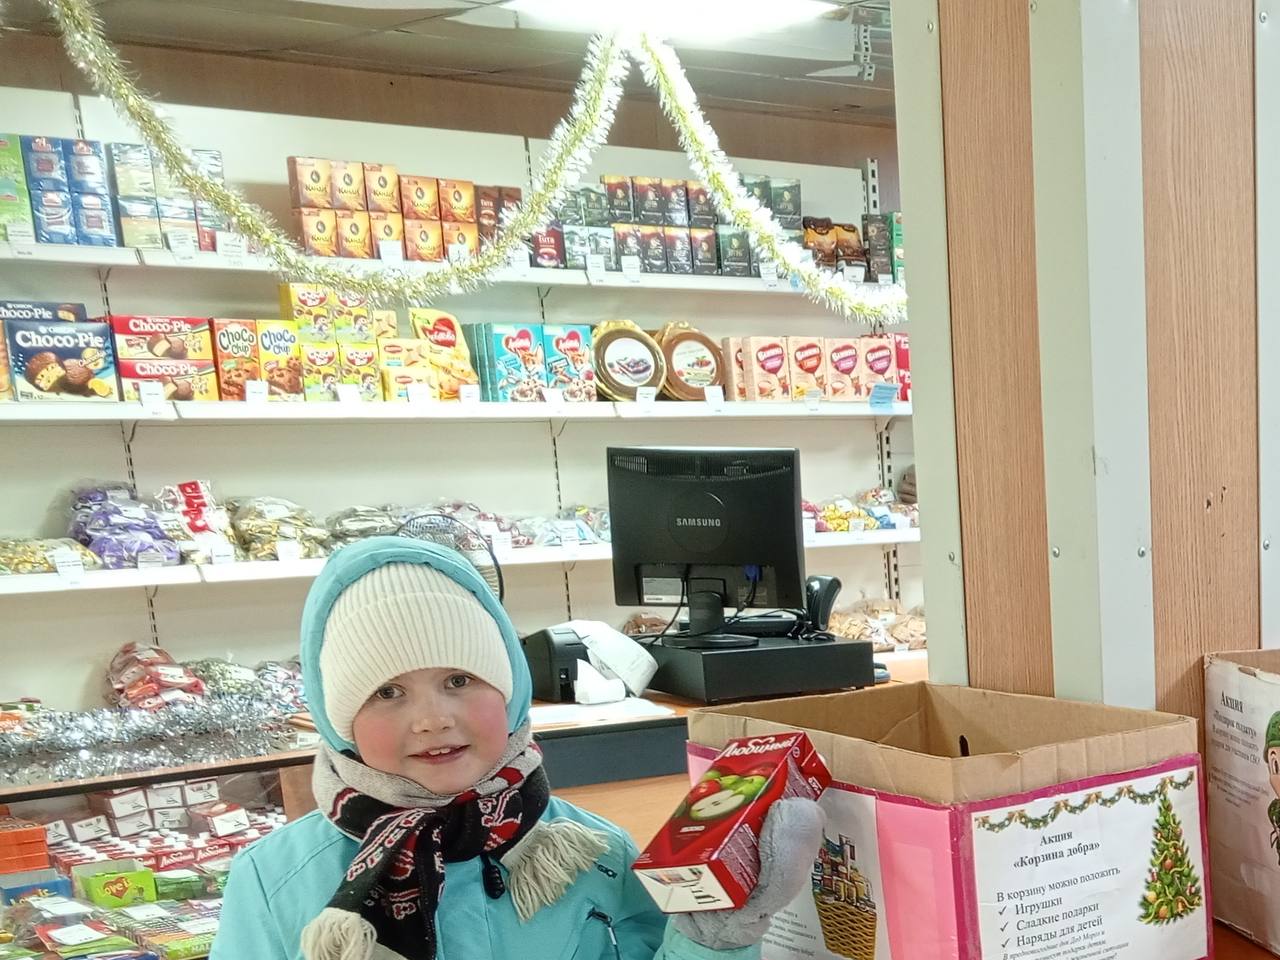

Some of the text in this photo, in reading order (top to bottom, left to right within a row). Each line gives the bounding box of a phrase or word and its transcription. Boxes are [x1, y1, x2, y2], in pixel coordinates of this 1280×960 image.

[676, 518, 721, 527] SAMSUNG
[722, 735, 797, 757] Любимый
[1040, 831, 1073, 846] Акция
[1013, 842, 1100, 869] «Корзина добра»
[996, 867, 1121, 902] В корзину можно положить
[1015, 897, 1063, 915] Игрушки
[1016, 902, 1100, 932] Сладкие подарки
[1016, 917, 1104, 947] Наряды для детей
[191, 943, 211, 953] HAL
